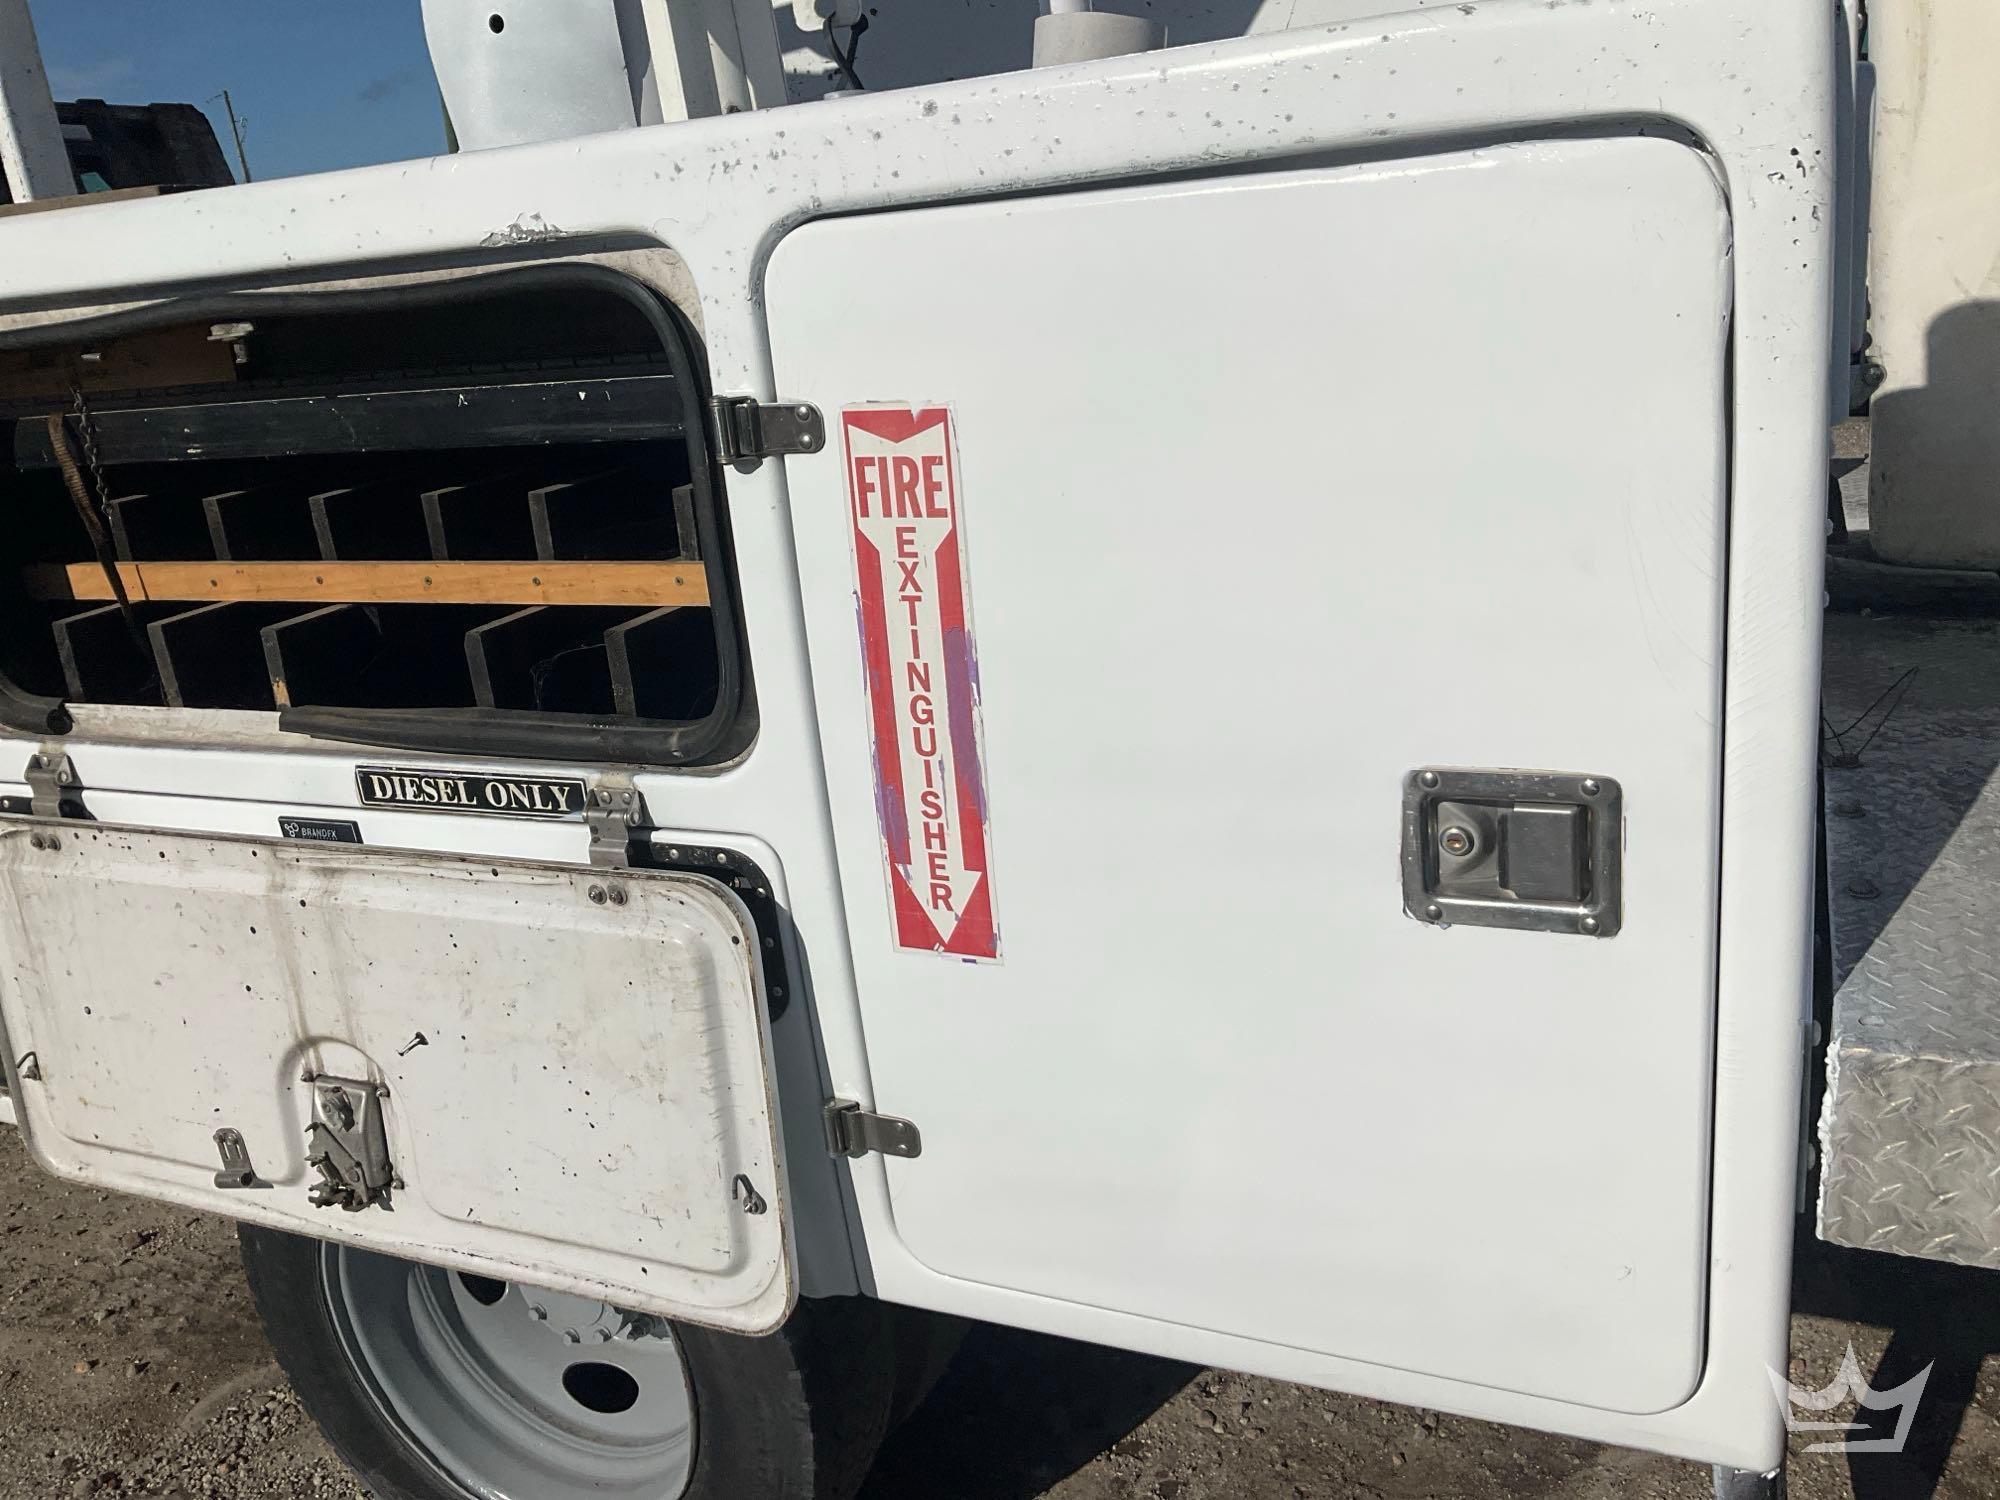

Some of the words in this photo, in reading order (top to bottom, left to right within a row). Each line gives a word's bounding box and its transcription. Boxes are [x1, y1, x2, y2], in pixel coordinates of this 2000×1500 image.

[854, 455, 949, 519] FIRE
[895, 526, 954, 912] EXTINGUISHER
[369, 774, 477, 806] DIESEL
[485, 781, 571, 812] ONLY
[301, 827, 338, 838] BRANDFX
